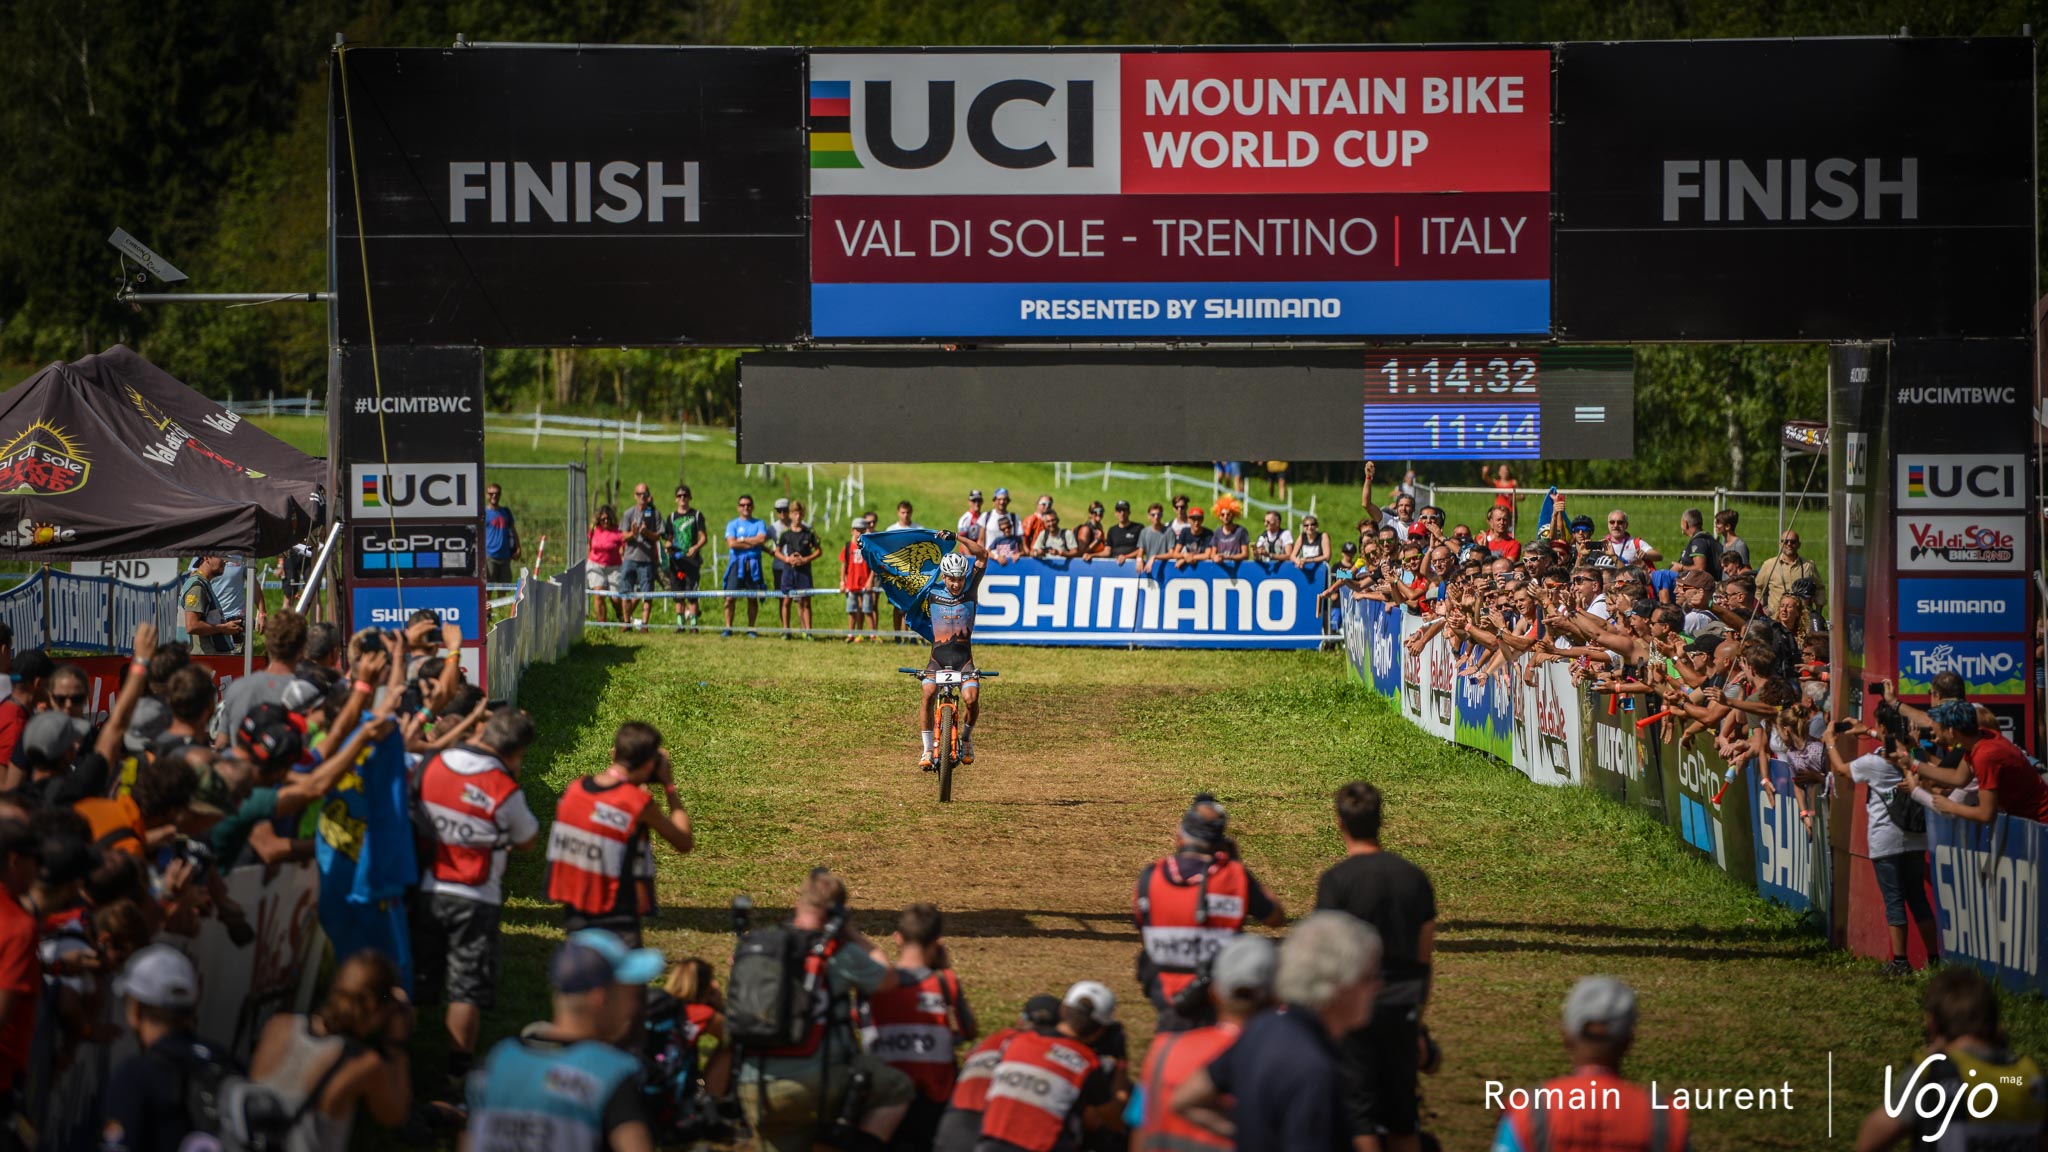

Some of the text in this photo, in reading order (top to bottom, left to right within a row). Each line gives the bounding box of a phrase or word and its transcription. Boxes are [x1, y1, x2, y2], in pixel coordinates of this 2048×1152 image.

[1144, 76, 1525, 116] MOUNTAIN BIKE
[864, 79, 1094, 169] UCI
[1143, 129, 1430, 169] WORLD CUP
[449, 160, 700, 223] FINISH
[1662, 157, 1918, 221] FINISH
[835, 219, 917, 258] VAL
[931, 220, 971, 258] DI
[987, 218, 1105, 258] SOLE
[1153, 217, 1378, 257] TRENTINO
[1421, 217, 1527, 255] ITALY
[1020, 298, 1341, 320] PRESENTED BY SHIMANO
[1381, 357, 1537, 394] 1:14:32
[355, 396, 472, 414] #UCIMTBWC
[1897, 387, 2016, 405] #UCIMTBWC
[1423, 413, 1540, 450] 11:44
[18, 446, 37, 460] di
[41, 452, 84, 473] sole
[382, 474, 467, 507] UCI
[1928, 464, 2015, 498] UCI
[1909, 523, 1943, 550] Val
[1946, 533, 1963, 548] di
[371, 607, 460, 622] SHIMNO
[974, 574, 1298, 632] SHIMANO
[1916, 599, 2006, 614] SHIMANO
[944, 673, 953, 682] 2
[1910, 650, 2014, 678] TRENTINO
